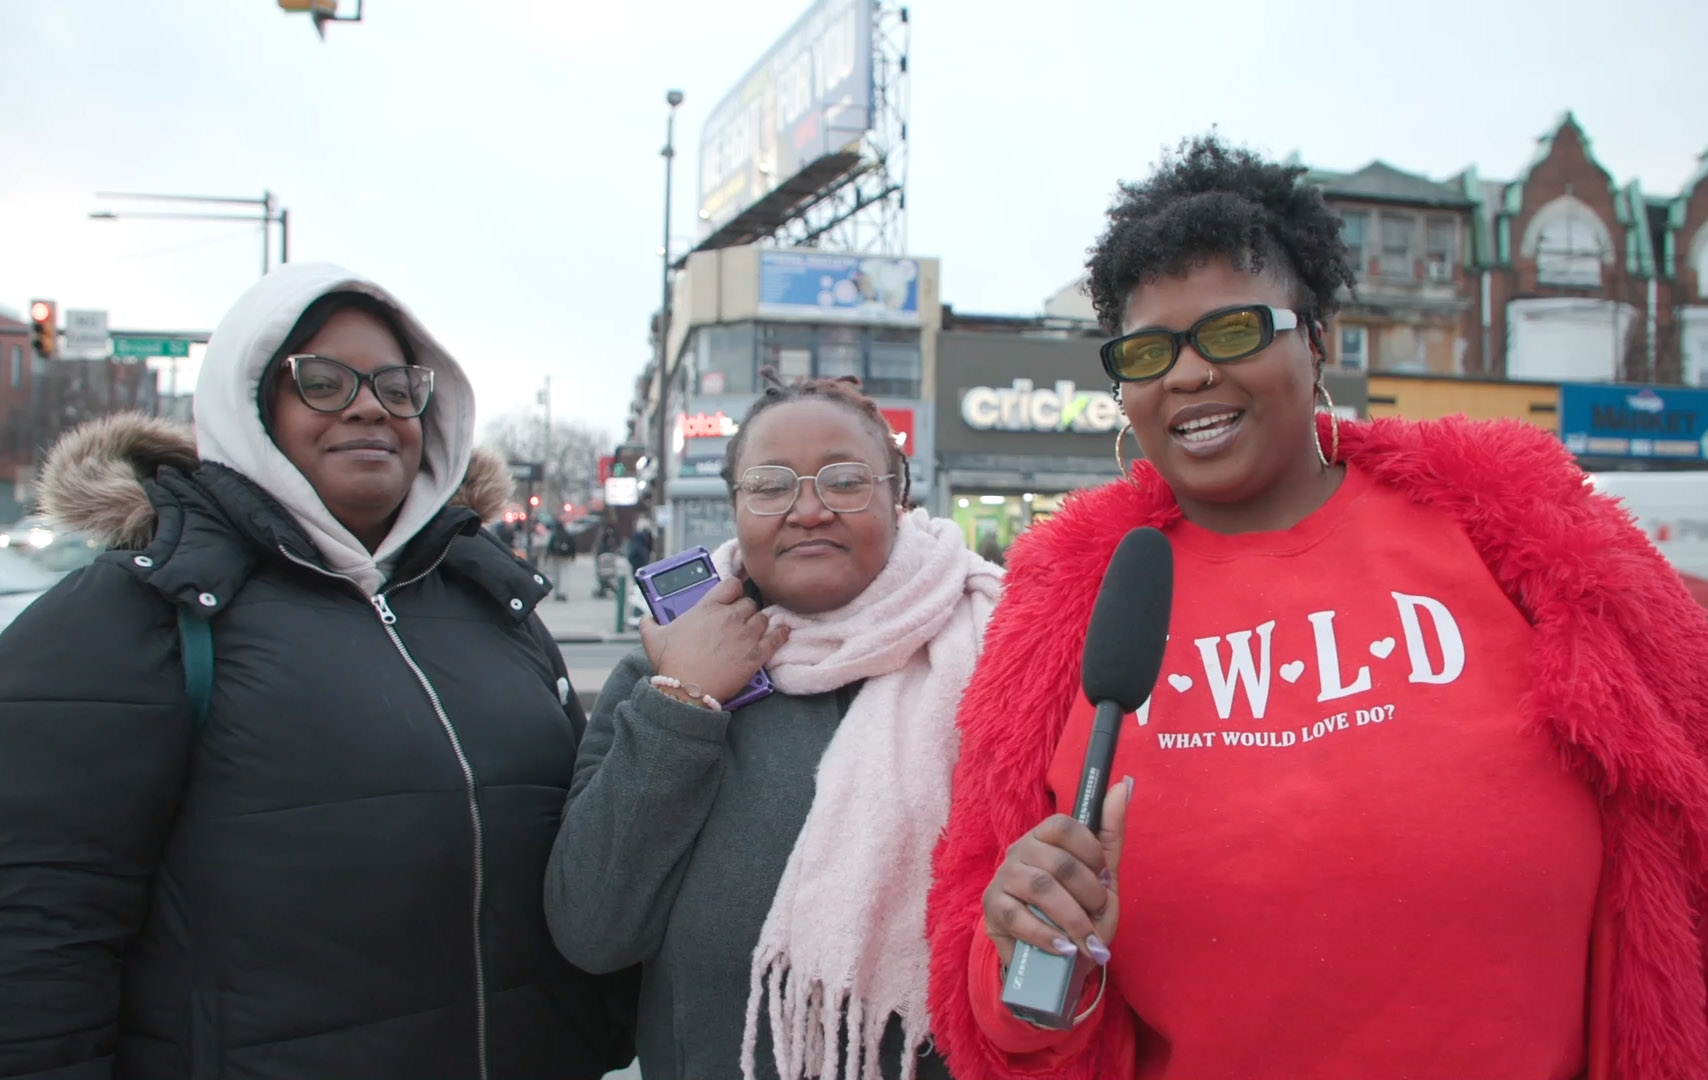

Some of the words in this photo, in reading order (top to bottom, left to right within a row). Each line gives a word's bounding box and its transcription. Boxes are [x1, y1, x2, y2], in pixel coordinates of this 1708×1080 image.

[1158, 732, 1216, 749] WHAT
[1222, 731, 1295, 748] WOULD
[1302, 712, 1349, 743] LOVE
[1356, 704, 1396, 726] DO?
